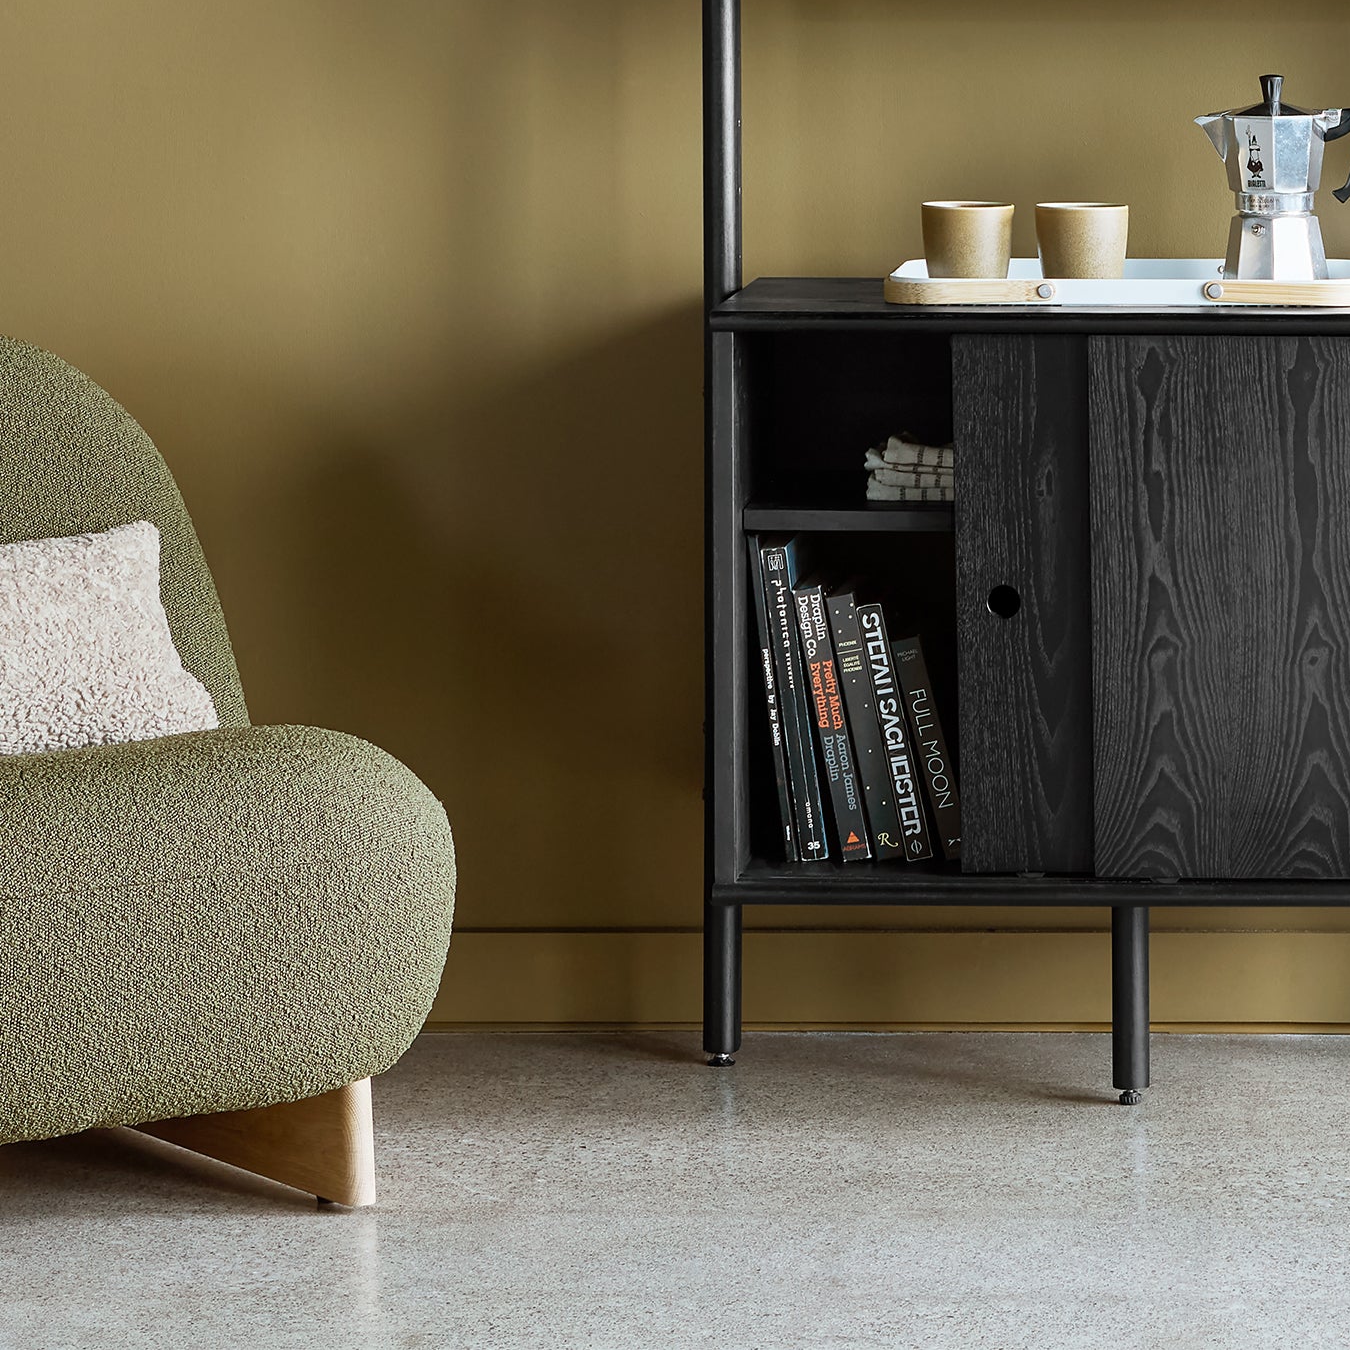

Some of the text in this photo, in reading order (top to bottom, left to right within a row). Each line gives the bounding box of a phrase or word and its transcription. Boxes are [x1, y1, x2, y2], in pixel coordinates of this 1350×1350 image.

[797, 595, 817, 659] Design Co.
[810, 593, 827, 640] Draplin
[761, 648, 775, 690] perspective
[768, 694, 776, 704] by
[769, 709, 778, 721] Jay
[810, 661, 830, 729] Everything
[822, 660, 844, 730] Pretty Much
[823, 736, 840, 782] Draplin
[836, 733, 857, 811] Aaron James
[909, 688, 954, 809] FULL MOON
[807, 840, 821, 851] 35
